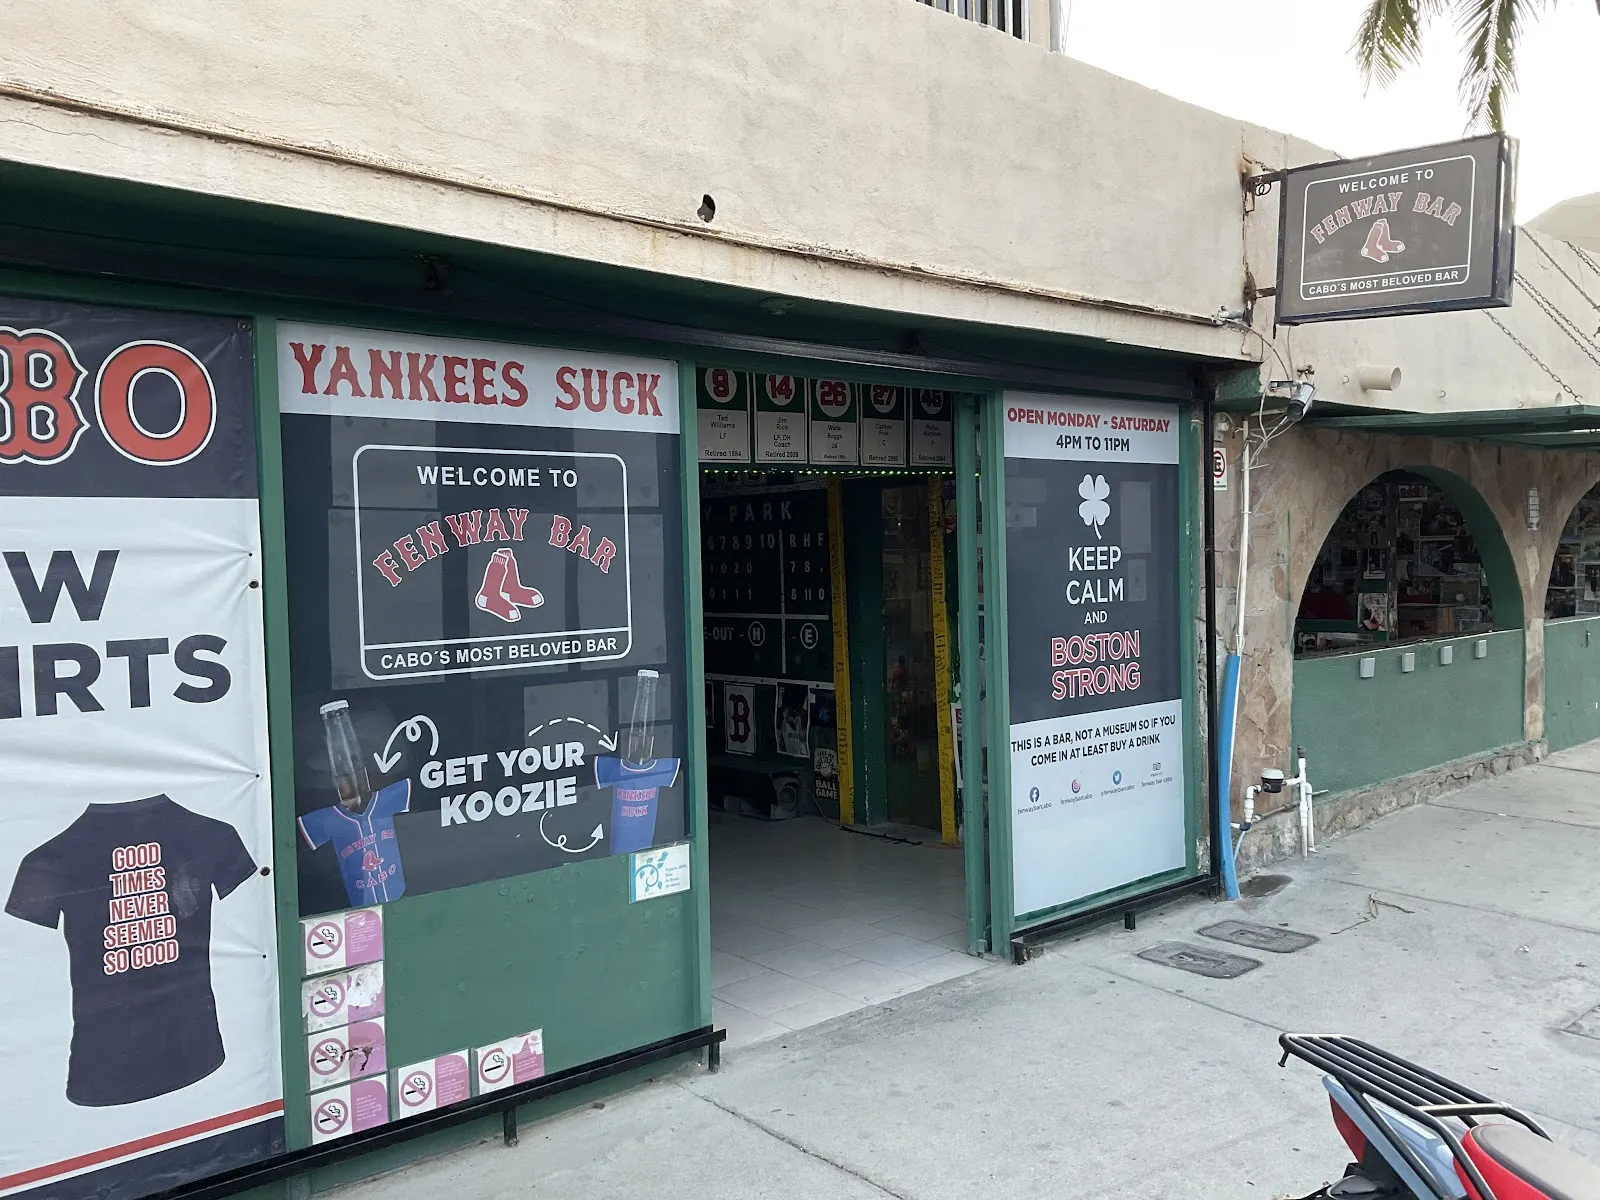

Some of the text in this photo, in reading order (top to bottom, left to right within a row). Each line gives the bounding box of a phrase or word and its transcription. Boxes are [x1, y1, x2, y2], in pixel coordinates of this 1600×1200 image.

[1339, 169, 1434, 194] WELCOME TO
[1310, 192, 1462, 244] FENWAY BAR
[1350, 280, 1378, 291] MOST
[1381, 273, 1432, 287] BELOVED
[1435, 270, 1459, 281] BAR
[288, 342, 663, 417] YANKEES SUCK
[768, 374, 793, 400] 14
[819, 380, 847, 407] 26
[873, 384, 896, 406] 27
[710, 421, 736, 429] Williams
[1007, 407, 1044, 425] OPEN
[1047, 411, 1101, 428] MONDAY
[1111, 416, 1170, 433] SATURDAY
[1056, 434, 1130, 452] 4PM TO 11PM
[417, 466, 578, 488] WELCOME TO
[729, 500, 793, 523] PARK
[373, 508, 617, 587] FENWAY BAR
[759, 533, 775, 549] 10
[1068, 545, 1122, 572] KEEP
[2, 549, 120, 624] W
[1066, 577, 1125, 605] CALM
[1084, 611, 1108, 625] AND
[456, 646, 503, 664] MOST
[508, 640, 582, 660] BELOVED
[586, 637, 617, 653] BAR
[1051, 629, 1140, 667] BOSTON
[1051, 661, 1141, 701] STRONG
[729, 694, 751, 744] B
[1011, 715, 1176, 752] THIS IS A BAR, NOT A MUSEUM SO IF YOU
[1031, 733, 1161, 766] COME IN AT LEAST BUY A DRINK
[419, 741, 585, 789] GET YOUR
[815, 779, 838, 791] BALL
[815, 787, 838, 800] GAME
[440, 776, 577, 827] KOOZIE
[112, 842, 161, 872] GOOD
[109, 866, 166, 898] TIMES
[109, 891, 169, 924] NEVER
[103, 915, 177, 949] SEEMED
[103, 940, 179, 975] SO GOOD
